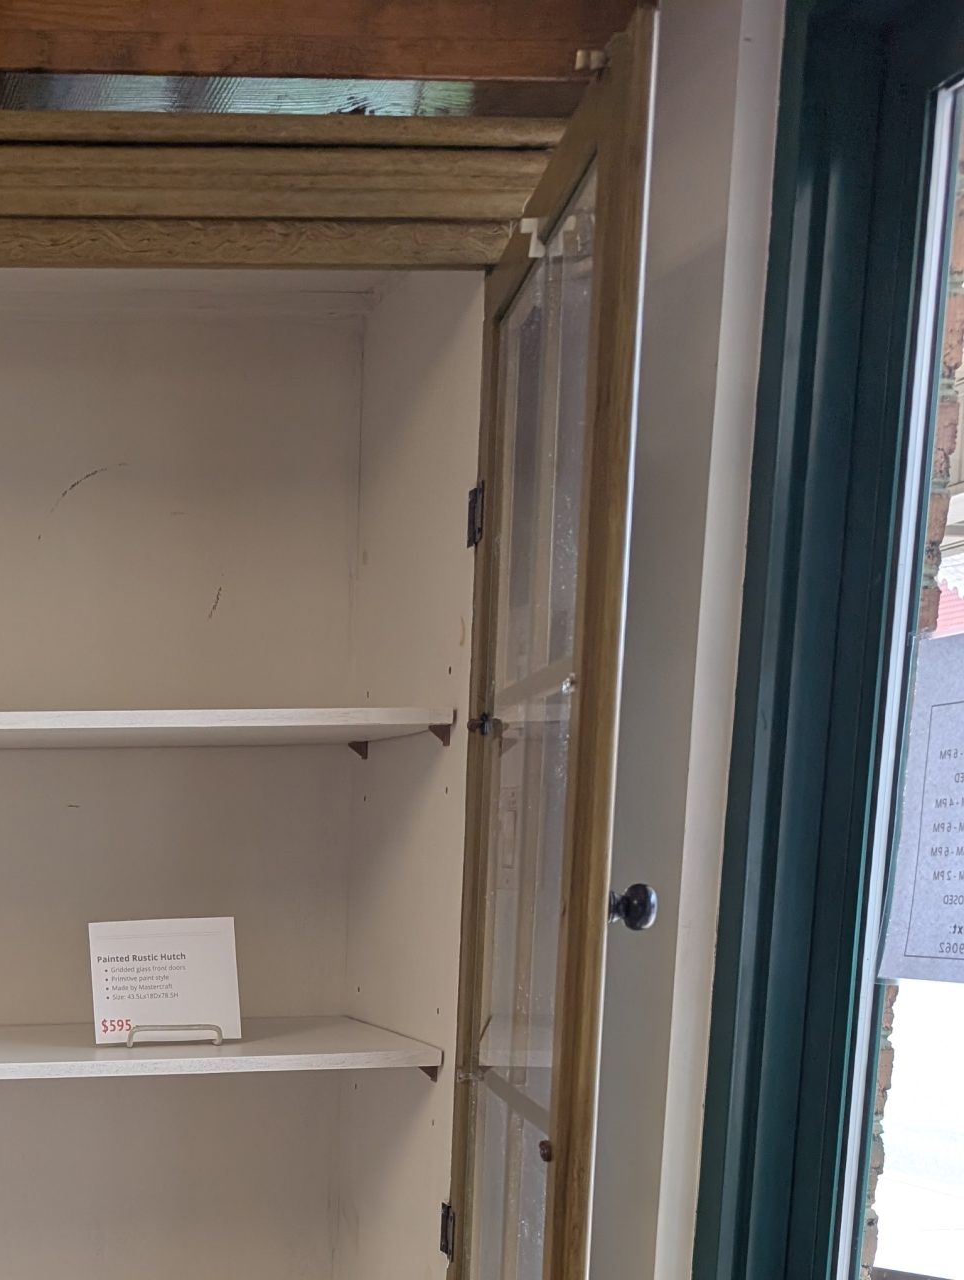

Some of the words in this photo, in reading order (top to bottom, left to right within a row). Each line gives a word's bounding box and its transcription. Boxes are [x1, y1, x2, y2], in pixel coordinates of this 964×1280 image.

[97, 954, 130, 963] Painted
[132, 953, 158, 962] Rustic
[160, 952, 186, 961] Hutch
[136, 966, 151, 974] glass
[155, 974, 170, 982] style
[130, 984, 137, 992] by
[138, 983, 173, 991] Mastercraft
[101, 1018, 132, 1034] $595
